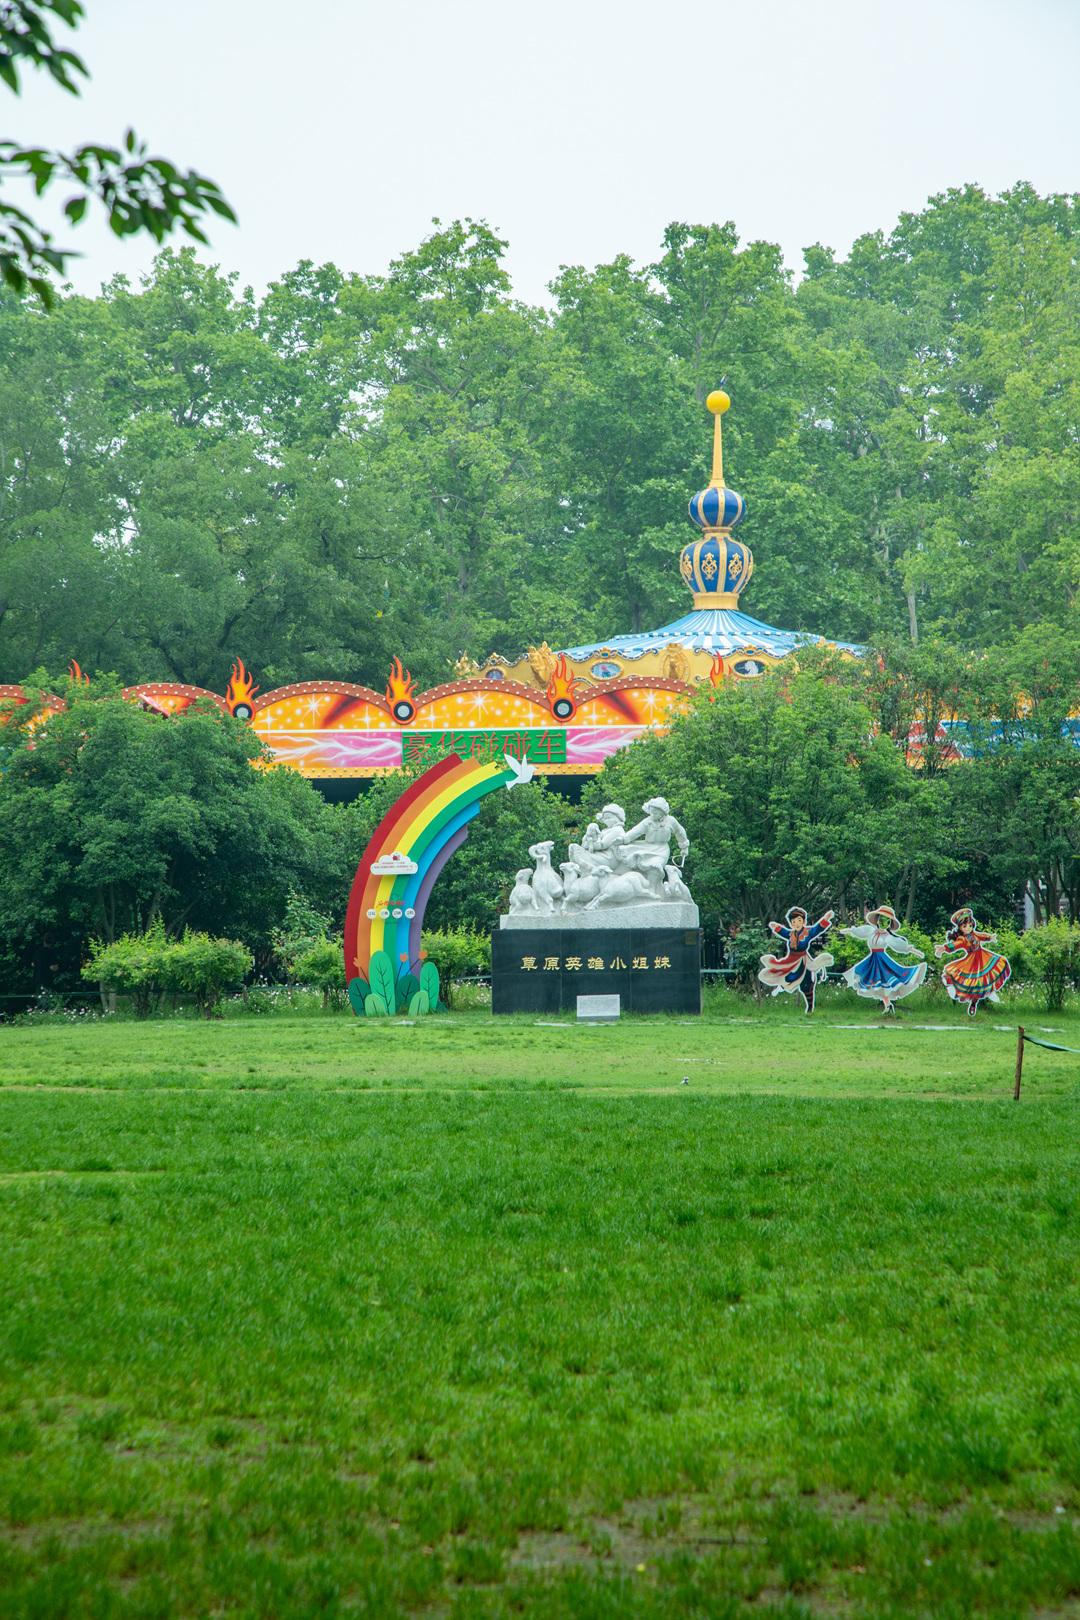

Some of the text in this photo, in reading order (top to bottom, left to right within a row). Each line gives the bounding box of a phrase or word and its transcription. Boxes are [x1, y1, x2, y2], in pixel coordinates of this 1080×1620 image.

[520, 956, 672, 971] 草原英雄小姐妹
